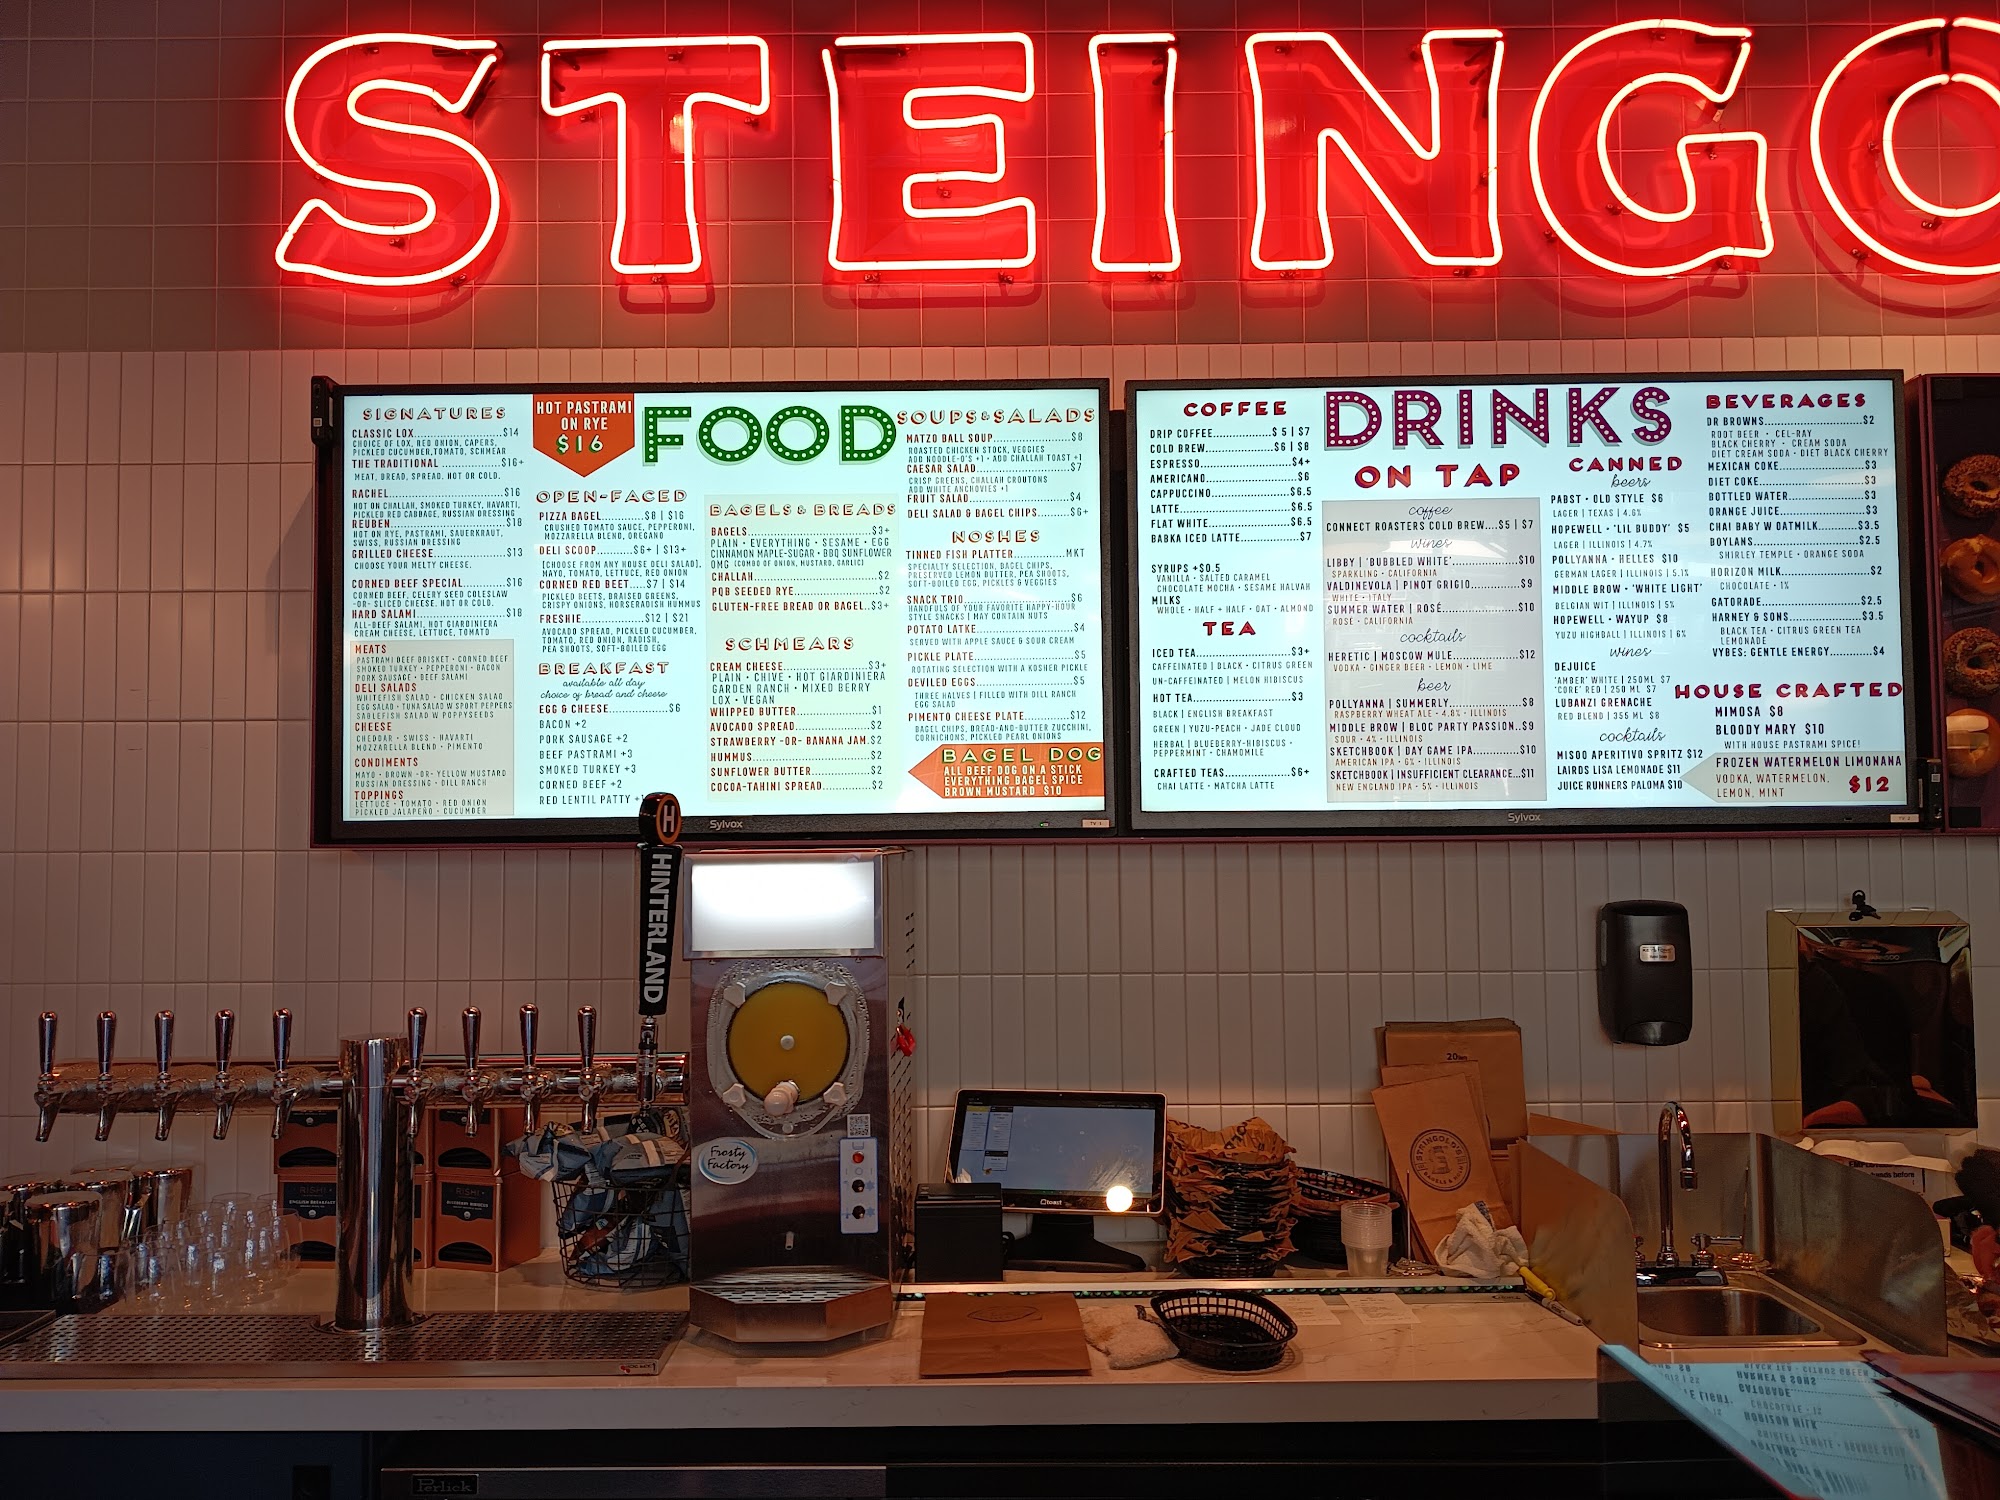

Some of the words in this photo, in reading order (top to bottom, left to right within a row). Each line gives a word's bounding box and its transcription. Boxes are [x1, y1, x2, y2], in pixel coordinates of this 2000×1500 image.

[275, 16, 2000, 286] STEINGO
[536, 401, 563, 414] HOT
[566, 401, 632, 414] PASTRAMI
[1706, 394, 1866, 409] BEVERAGES
[362, 407, 507, 421] SIGNATURES
[1184, 402, 1287, 417] COFFEE
[561, 418, 580, 431] ON
[583, 417, 608, 430] RYE
[1324, 387, 1672, 452] DRINKS
[1707, 417, 1720, 426] DR
[1723, 416, 1764, 426] BROWNS
[1863, 415, 1875, 424] $2
[352, 428, 393, 438] CLASSIC
[396, 428, 414, 438] LOX
[503, 428, 519, 437] $14
[643, 405, 897, 467] FOOD
[907, 434, 938, 443] MATZO
[942, 434, 965, 443] BALL
[968, 433, 993, 443] SOUP
[1071, 432, 1083, 442] $8
[556, 434, 604, 454] $16
[352, 459, 371, 469] THE
[374, 459, 439, 468] TRADITIONAL
[501, 458, 524, 468] $16+
[1150, 459, 1200, 469] ESPRESSO
[1292, 457, 1310, 467] $4+
[1568, 456, 1683, 472] CANNED
[1354, 464, 1412, 488] ON
[1436, 463, 1520, 487] TAP
[1611, 475, 1651, 487] beers
[536, 490, 687, 503] OPEN-FACED
[1151, 488, 1211, 499] CAPPUCCINO
[1291, 486, 1312, 497] $6.5
[710, 504, 793, 516] BAGELS
[797, 504, 807, 516] &
[814, 504, 896, 516] BREADS
[1408, 504, 1453, 519] coffee
[352, 519, 390, 529] REUBEN
[1709, 522, 1731, 531] CHAI
[1734, 521, 1761, 531] BABY
[1764, 521, 1772, 530] W
[1776, 521, 1818, 530] OATMILK
[1858, 519, 1879, 529] $3.5
[952, 530, 1040, 543] NOSHES
[1410, 537, 1452, 550] wines
[906, 550, 942, 560] TINNED
[946, 549, 968, 559] FISH
[971, 549, 1013, 559] PLATTER
[1066, 548, 1084, 558] MKT
[1151, 564, 1188, 574] SYRUPS
[1192, 563, 1221, 573] +$0.5
[1203, 621, 1256, 636] TEA
[910, 637, 938, 647] SERVED
[942, 637, 961, 646] WITH
[965, 637, 987, 646] APPLE
[990, 636, 1014, 645] SAUCE
[1017, 636, 1023, 645] &
[1026, 636, 1046, 645] SOUR
[1050, 636, 1074, 644] CREAM
[1399, 628, 1466, 644] cocktails
[355, 644, 387, 654] MEATS
[725, 637, 855, 650] SCHMEARS
[1713, 647, 1747, 657] VYBES:
[1750, 646, 1788, 657] GENTLE
[1792, 646, 1830, 656] ENERGY
[1873, 645, 1884, 655] $4
[539, 662, 669, 675] BREAKFAST
[1554, 661, 1596, 671] DEJUICE
[355, 682, 377, 692] DELI
[381, 682, 417, 692] SALADS
[562, 678, 606, 688] available
[609, 678, 622, 688] all
[626, 678, 645, 690] day
[1416, 678, 1451, 692] beer
[1675, 684, 1762, 699] HOUSE
[1776, 683, 1903, 698] CRAFTED
[1555, 698, 1596, 708] LUBANZI
[1600, 697, 1652, 707] GRENACHE
[710, 707, 755, 717] WHIPPED
[759, 706, 796, 716] BUTTER
[872, 705, 882, 715] $1
[1715, 707, 1761, 717] MIMOSA
[1770, 706, 1783, 716] $8
[539, 720, 571, 729] BACON
[575, 720, 587, 728] +2
[1716, 724, 1761, 735] BLOODY
[1765, 724, 1796, 734] MARY
[1805, 723, 1825, 734] $10
[539, 735, 565, 744] PORK
[568, 734, 612, 743] SAUSAGE
[616, 734, 628, 743] +2
[539, 750, 563, 759] BEEF
[567, 749, 617, 758] PASTRAMI
[621, 749, 632, 758] +3
[710, 751, 752, 762] HUMMUS
[871, 750, 882, 760] $2
[941, 748, 1035, 763] BAGEL
[1049, 746, 1101, 763] DOG
[355, 758, 418, 768] CONDIMENTS
[1716, 757, 1759, 767] FROZEN
[1763, 756, 1840, 767] WATERMELON
[1845, 756, 1902, 766] LIMONANA
[539, 765, 579, 774] SMOKED
[582, 764, 621, 774] TURKEY
[624, 764, 636, 773] +3
[944, 765, 963, 776] ALL
[966, 765, 993, 775] BEEF
[997, 765, 1018, 775] DOG
[1021, 765, 1036, 775] ON
[1039, 765, 1046, 775] A
[1049, 764, 1082, 774] STICK
[1154, 768, 1196, 778] CRAFTED
[1200, 768, 1224, 777] TEAS
[1291, 766, 1310, 777] $6+
[944, 776, 1011, 787] EVERYTHING
[1015, 775, 1048, 786] BAGEL
[1051, 775, 1083, 785] SPICE
[1557, 780, 1583, 790] JUICE
[1586, 780, 1628, 790] RUNNERS
[1631, 779, 1664, 789] PALOMA
[1667, 779, 1682, 789] $10
[1716, 773, 1751, 784] VODKA,
[1756, 773, 1830, 784] WATERMELON,
[1849, 776, 1890, 793] $12
[944, 786, 981, 797] BROWN
[986, 786, 1035, 797] MUSTARD
[1044, 785, 1062, 796] $10
[1717, 787, 1754, 798] LEMON,
[1760, 787, 1784, 797] MINT
[662, 806, 675, 833] H
[1508, 812, 1541, 823] Sylvox
[709, 819, 743, 830] Sylvox
[642, 853, 672, 1003] HINTERLAND
[711, 1146, 746, 1161] Frosty
[708, 1158, 751, 1173] Factory
[299, 1186, 327, 1195] RISHI
[455, 1186, 480, 1196] RISHI
[1046, 1198, 1063, 1206] toast
[417, 1478, 473, 1493] Perlick
